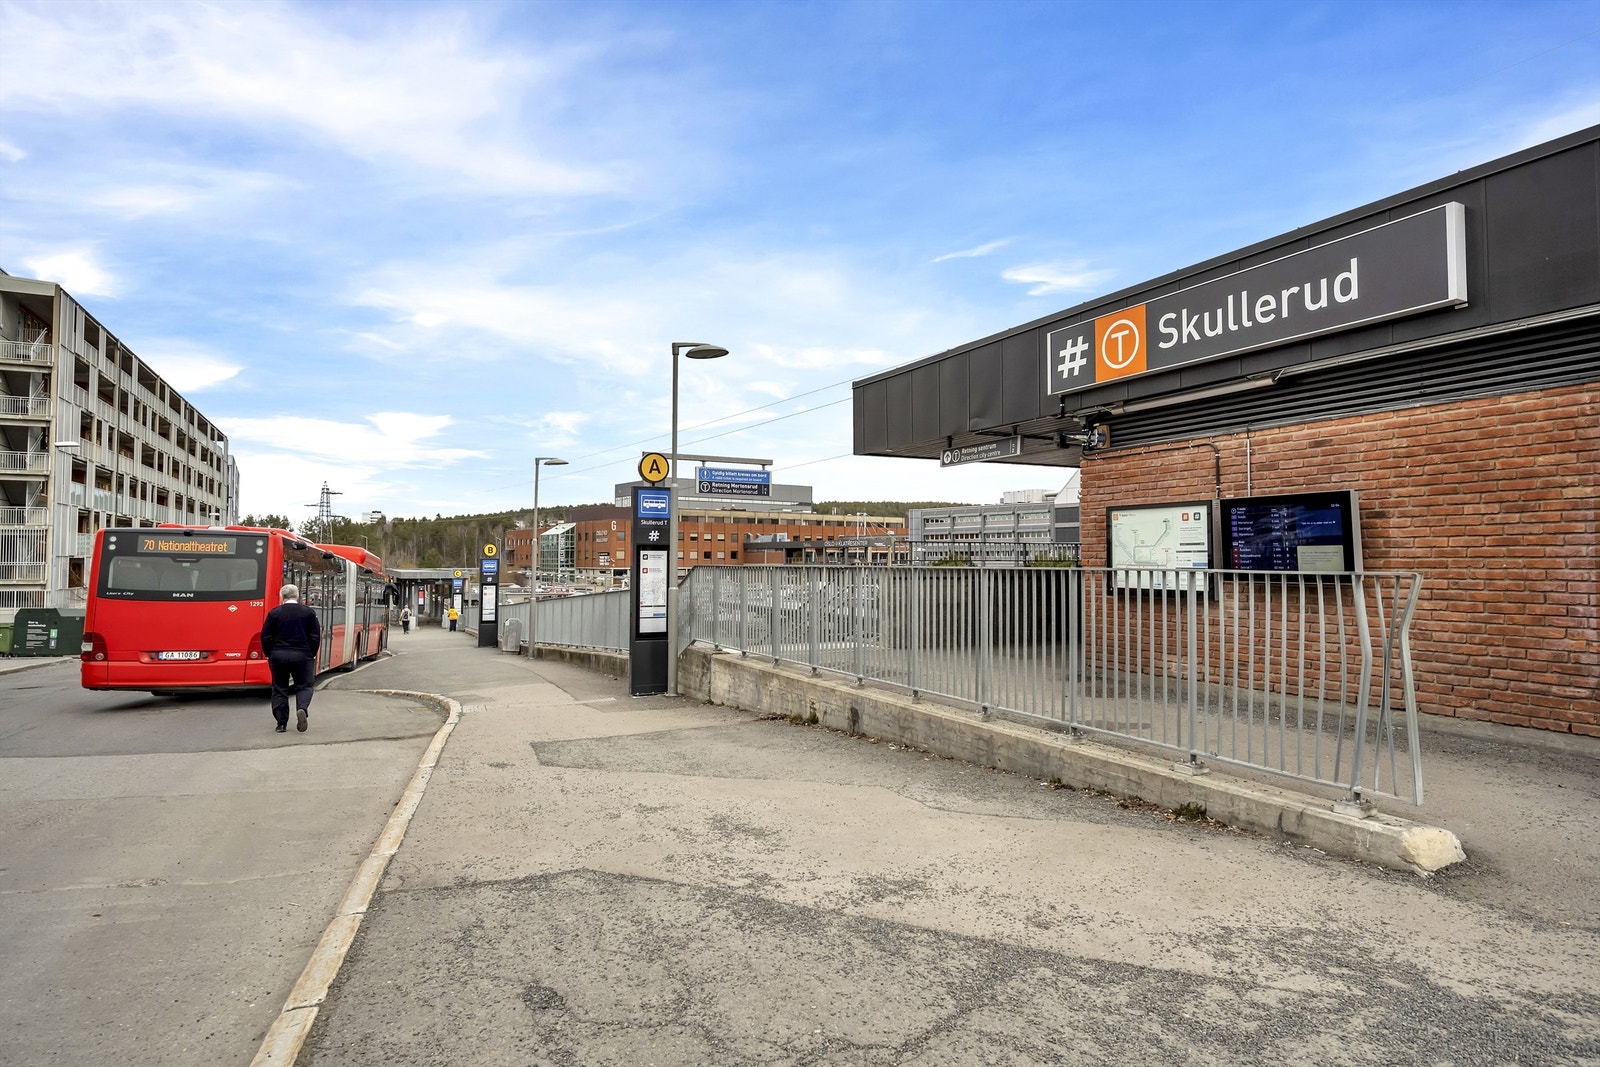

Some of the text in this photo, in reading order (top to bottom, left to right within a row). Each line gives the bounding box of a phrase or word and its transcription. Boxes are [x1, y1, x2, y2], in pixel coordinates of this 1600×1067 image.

[1158, 257, 1359, 349] Skullerud
[961, 453, 979, 461] Direction
[648, 459, 661, 474] A
[143, 539, 228, 552] 70 Nationaltheatret
[487, 546, 494, 554] B
